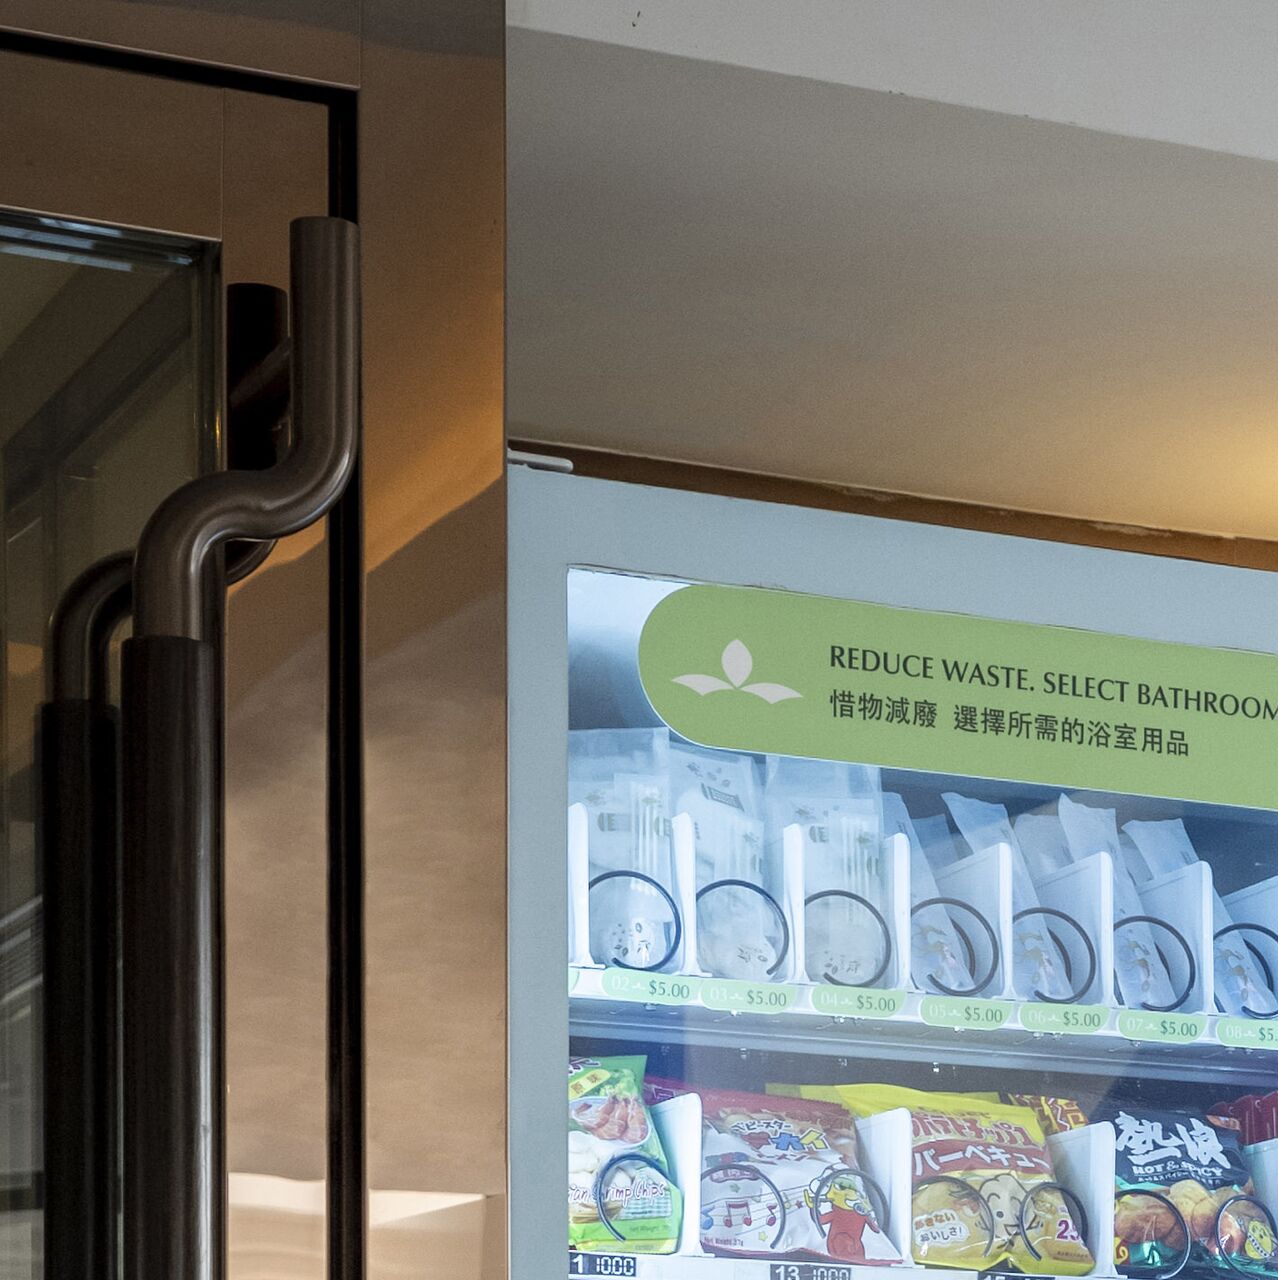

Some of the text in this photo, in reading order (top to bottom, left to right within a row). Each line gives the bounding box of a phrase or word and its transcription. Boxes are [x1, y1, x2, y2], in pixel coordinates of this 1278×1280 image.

[830, 645, 934, 680] REDUCE
[941, 658, 1036, 692] WASTE.
[1043, 671, 1130, 703] SELECT
[830, 688, 1190, 757] 惜物減廢 選擇所需的浴室用品
[648, 980, 690, 1000] $5.00
[747, 987, 787, 1007] $5.00
[856, 994, 896, 1012] $5.00
[963, 1005, 1003, 1024] $5.00
[1063, 1012, 1100, 1028] $5.00
[1159, 1020, 1198, 1037] $5.00
[914, 1145, 1050, 1176] バーベキュー
[1132, 1161, 1223, 1177] HOT & SPICY
[634, 1181, 665, 1205] Chips
